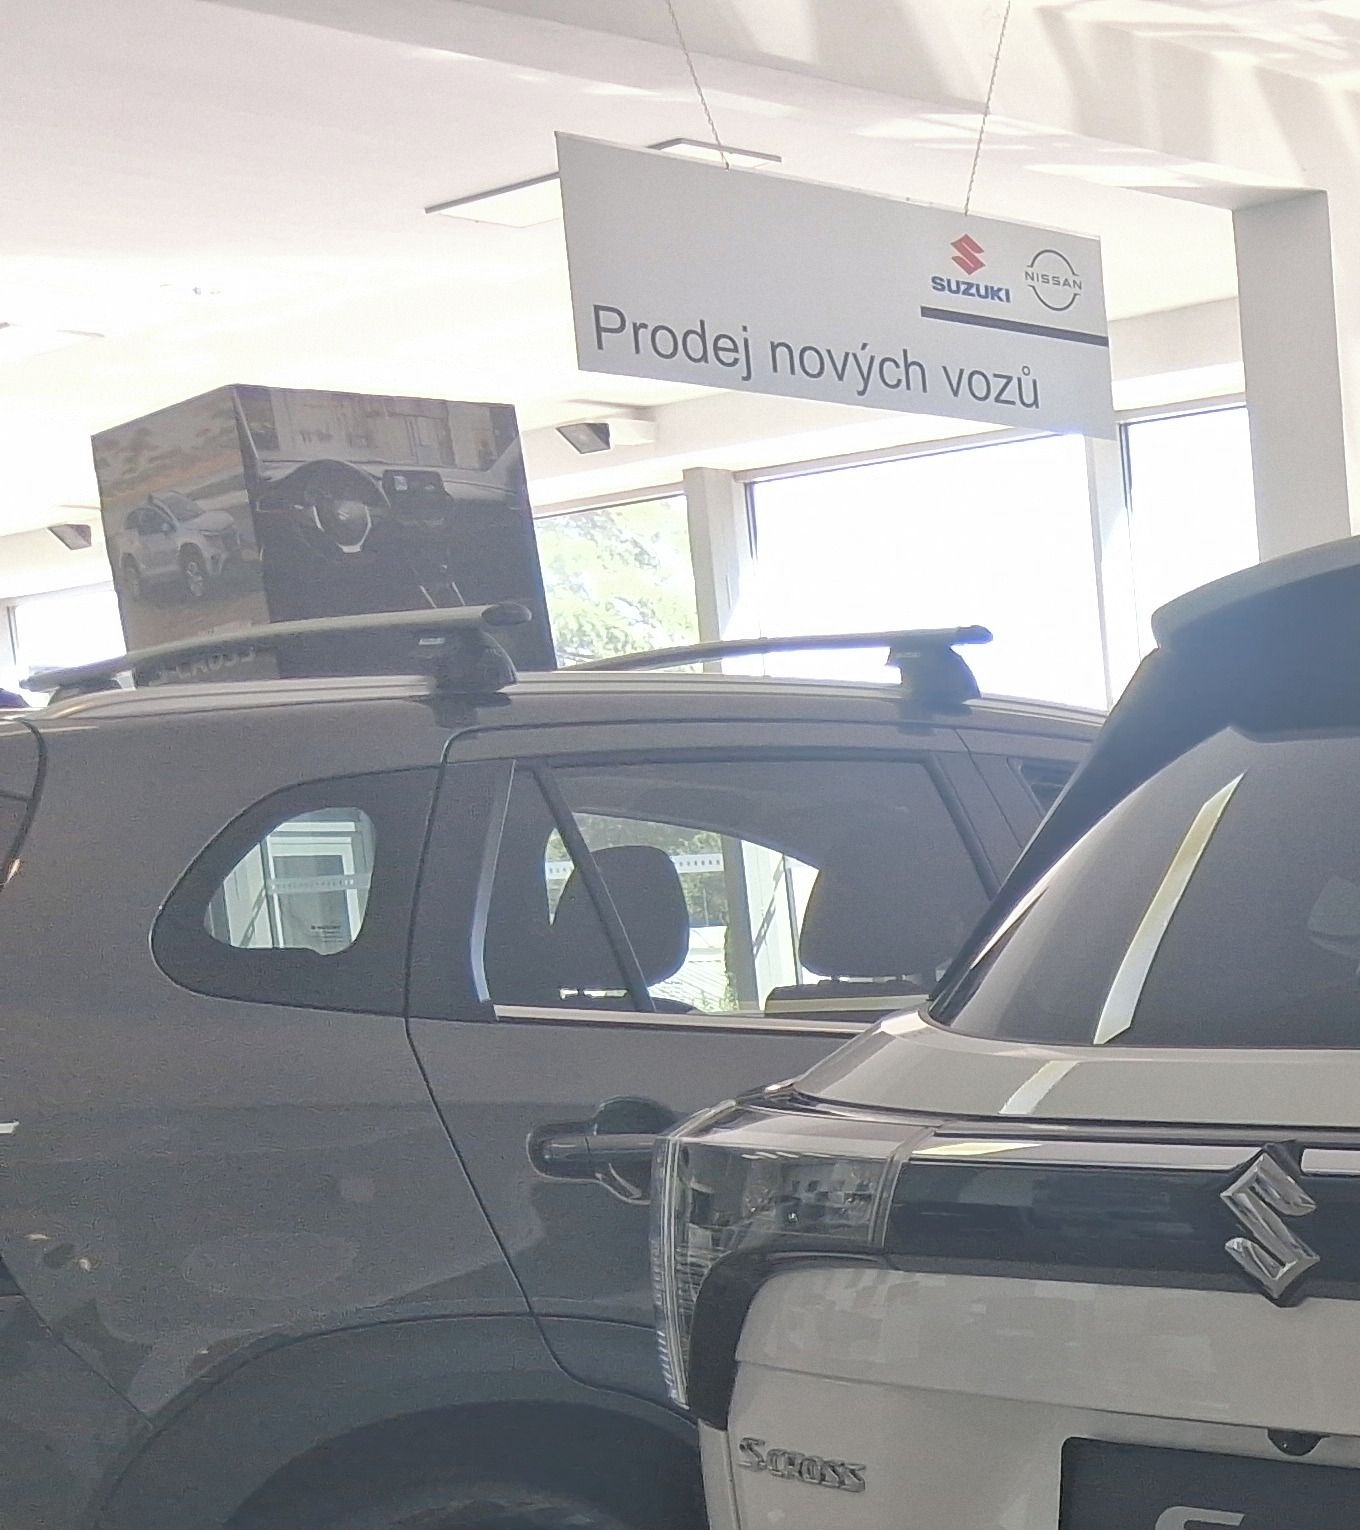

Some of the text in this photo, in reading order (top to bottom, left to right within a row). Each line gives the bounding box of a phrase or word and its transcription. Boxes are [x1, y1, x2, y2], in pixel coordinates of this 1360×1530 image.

[931, 275, 1012, 304] SUZUKI
[1024, 271, 1083, 290] NISSAN
[593, 304, 1040, 409] Prodej nových vozů
